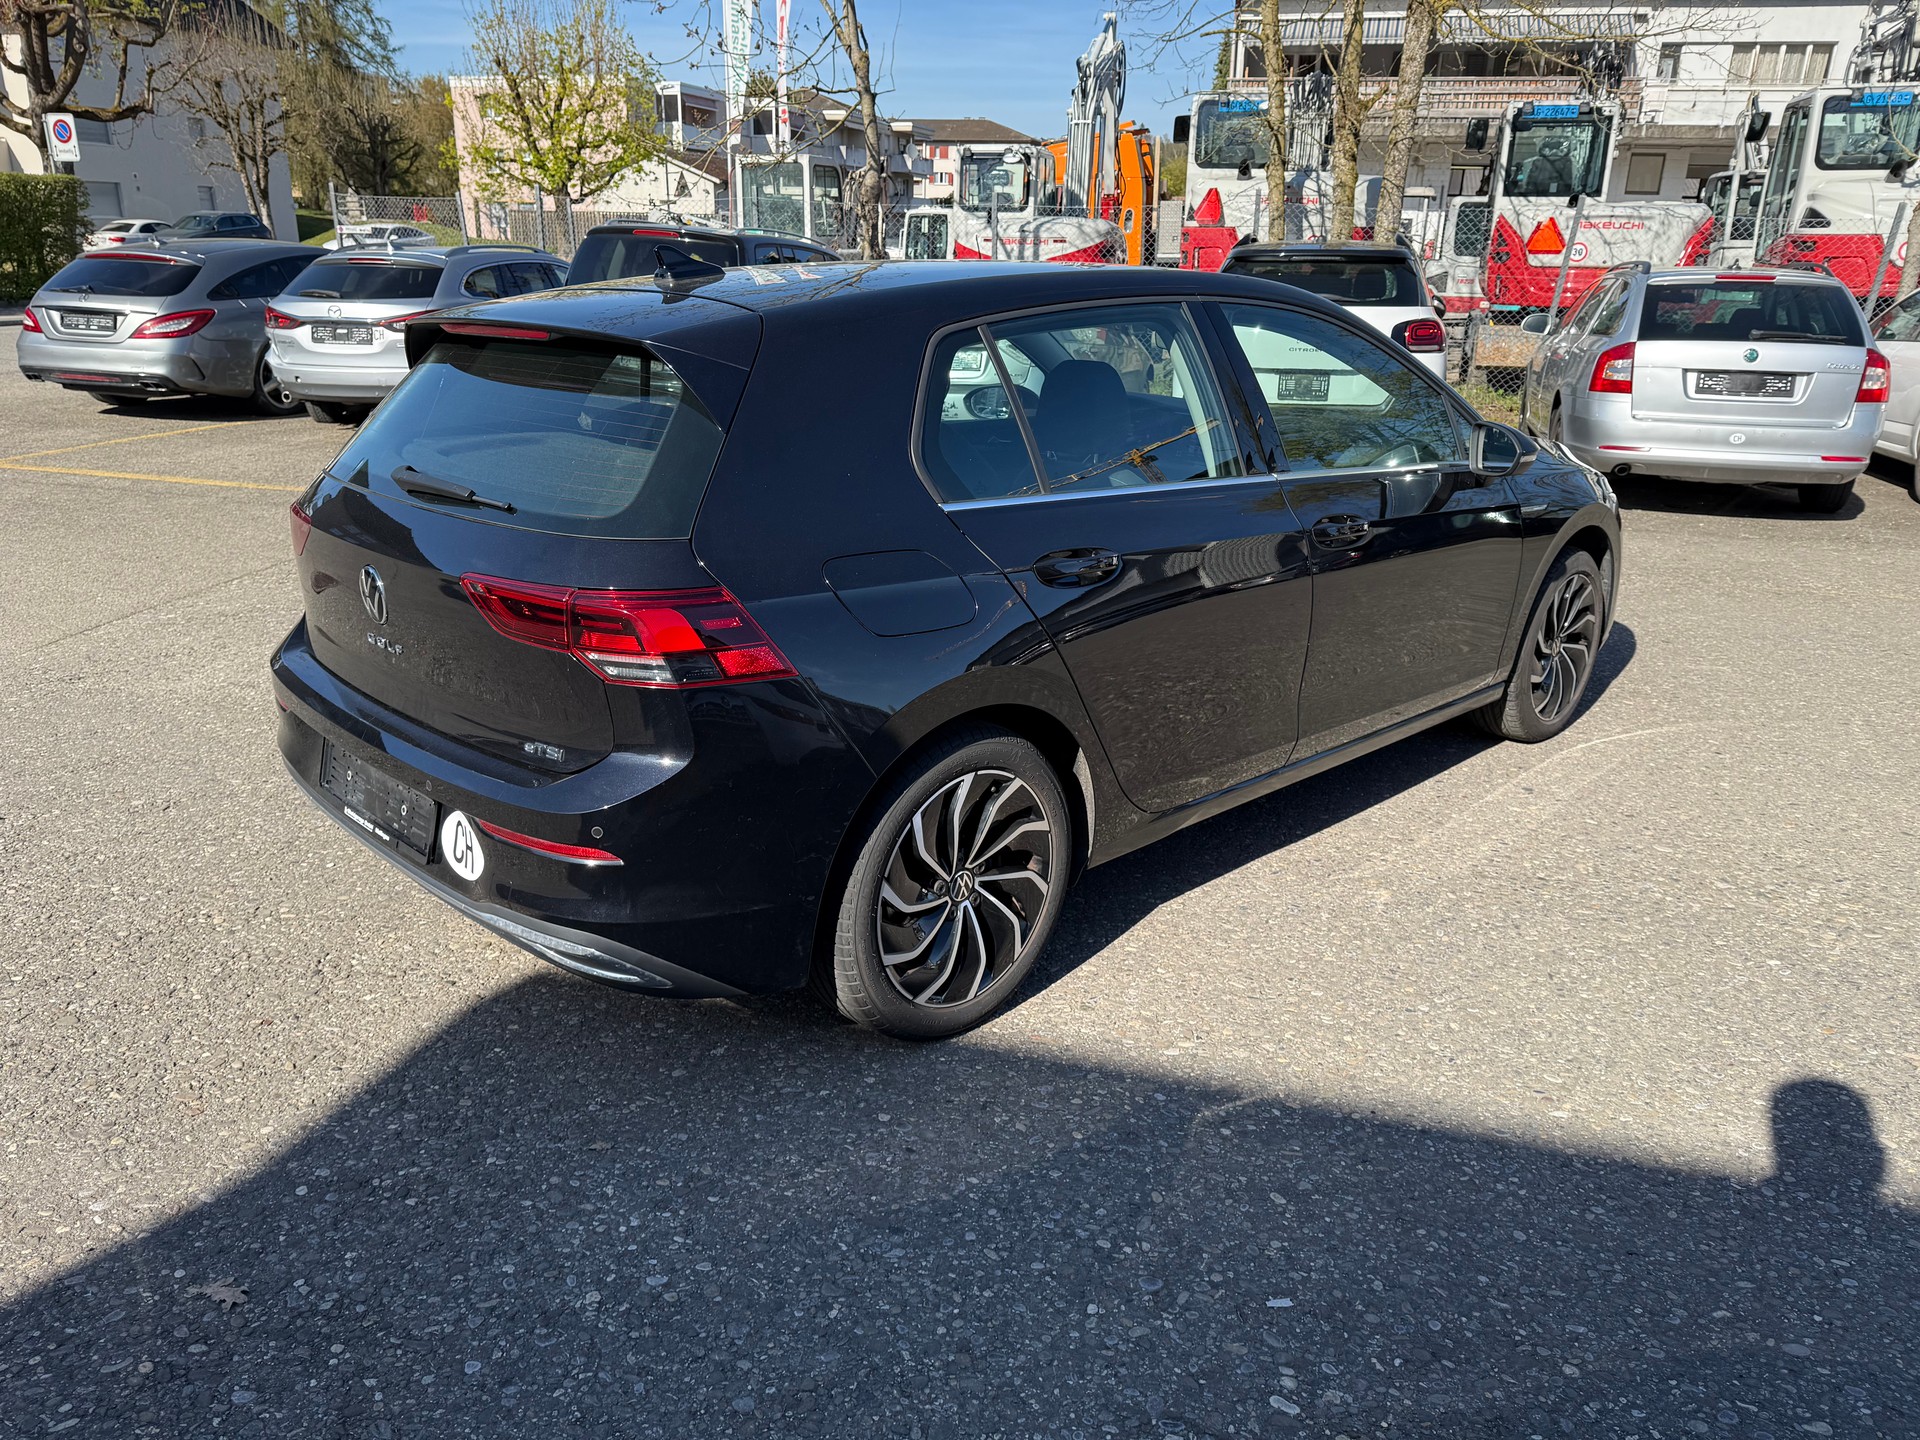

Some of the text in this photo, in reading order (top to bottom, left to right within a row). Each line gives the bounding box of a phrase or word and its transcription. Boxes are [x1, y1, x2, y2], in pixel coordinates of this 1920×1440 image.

[1572, 247, 1584, 257] 30
[373, 329, 385, 341] CH
[1732, 434, 1743, 442] CH
[367, 632, 403, 655] GOLF
[524, 741, 566, 763] eTSI
[453, 820, 474, 874] CH
